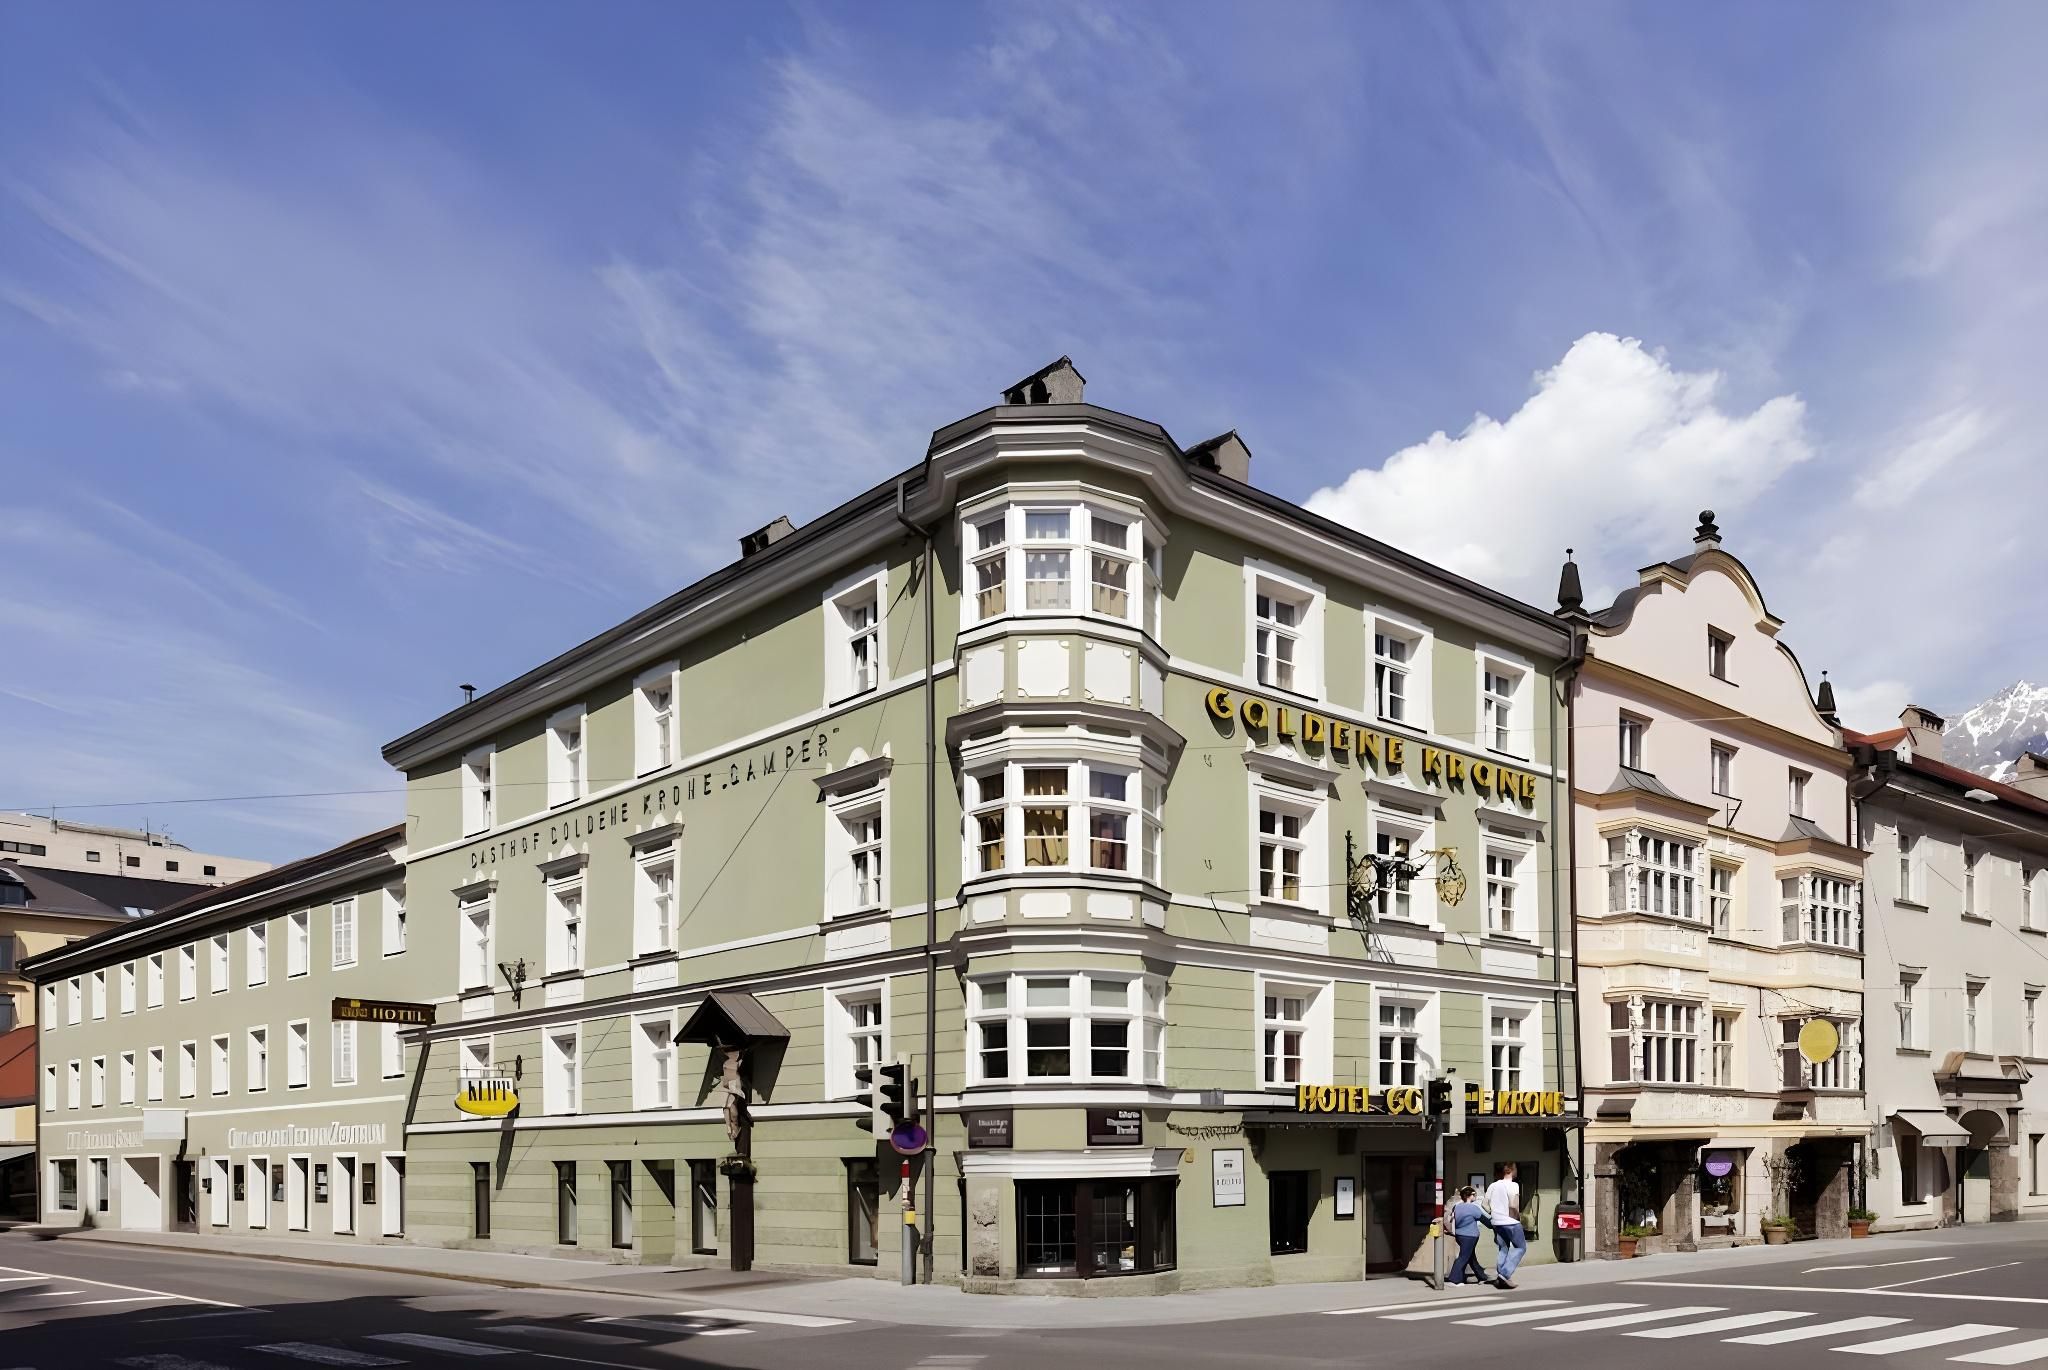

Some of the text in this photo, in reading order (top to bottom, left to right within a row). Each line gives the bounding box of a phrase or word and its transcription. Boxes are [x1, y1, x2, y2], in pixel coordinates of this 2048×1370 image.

[1205, 686, 1536, 800] GOLDENE KRONE
[1298, 1085, 1370, 1113] HOTEL
[1497, 1090, 1566, 1115] KRONE
